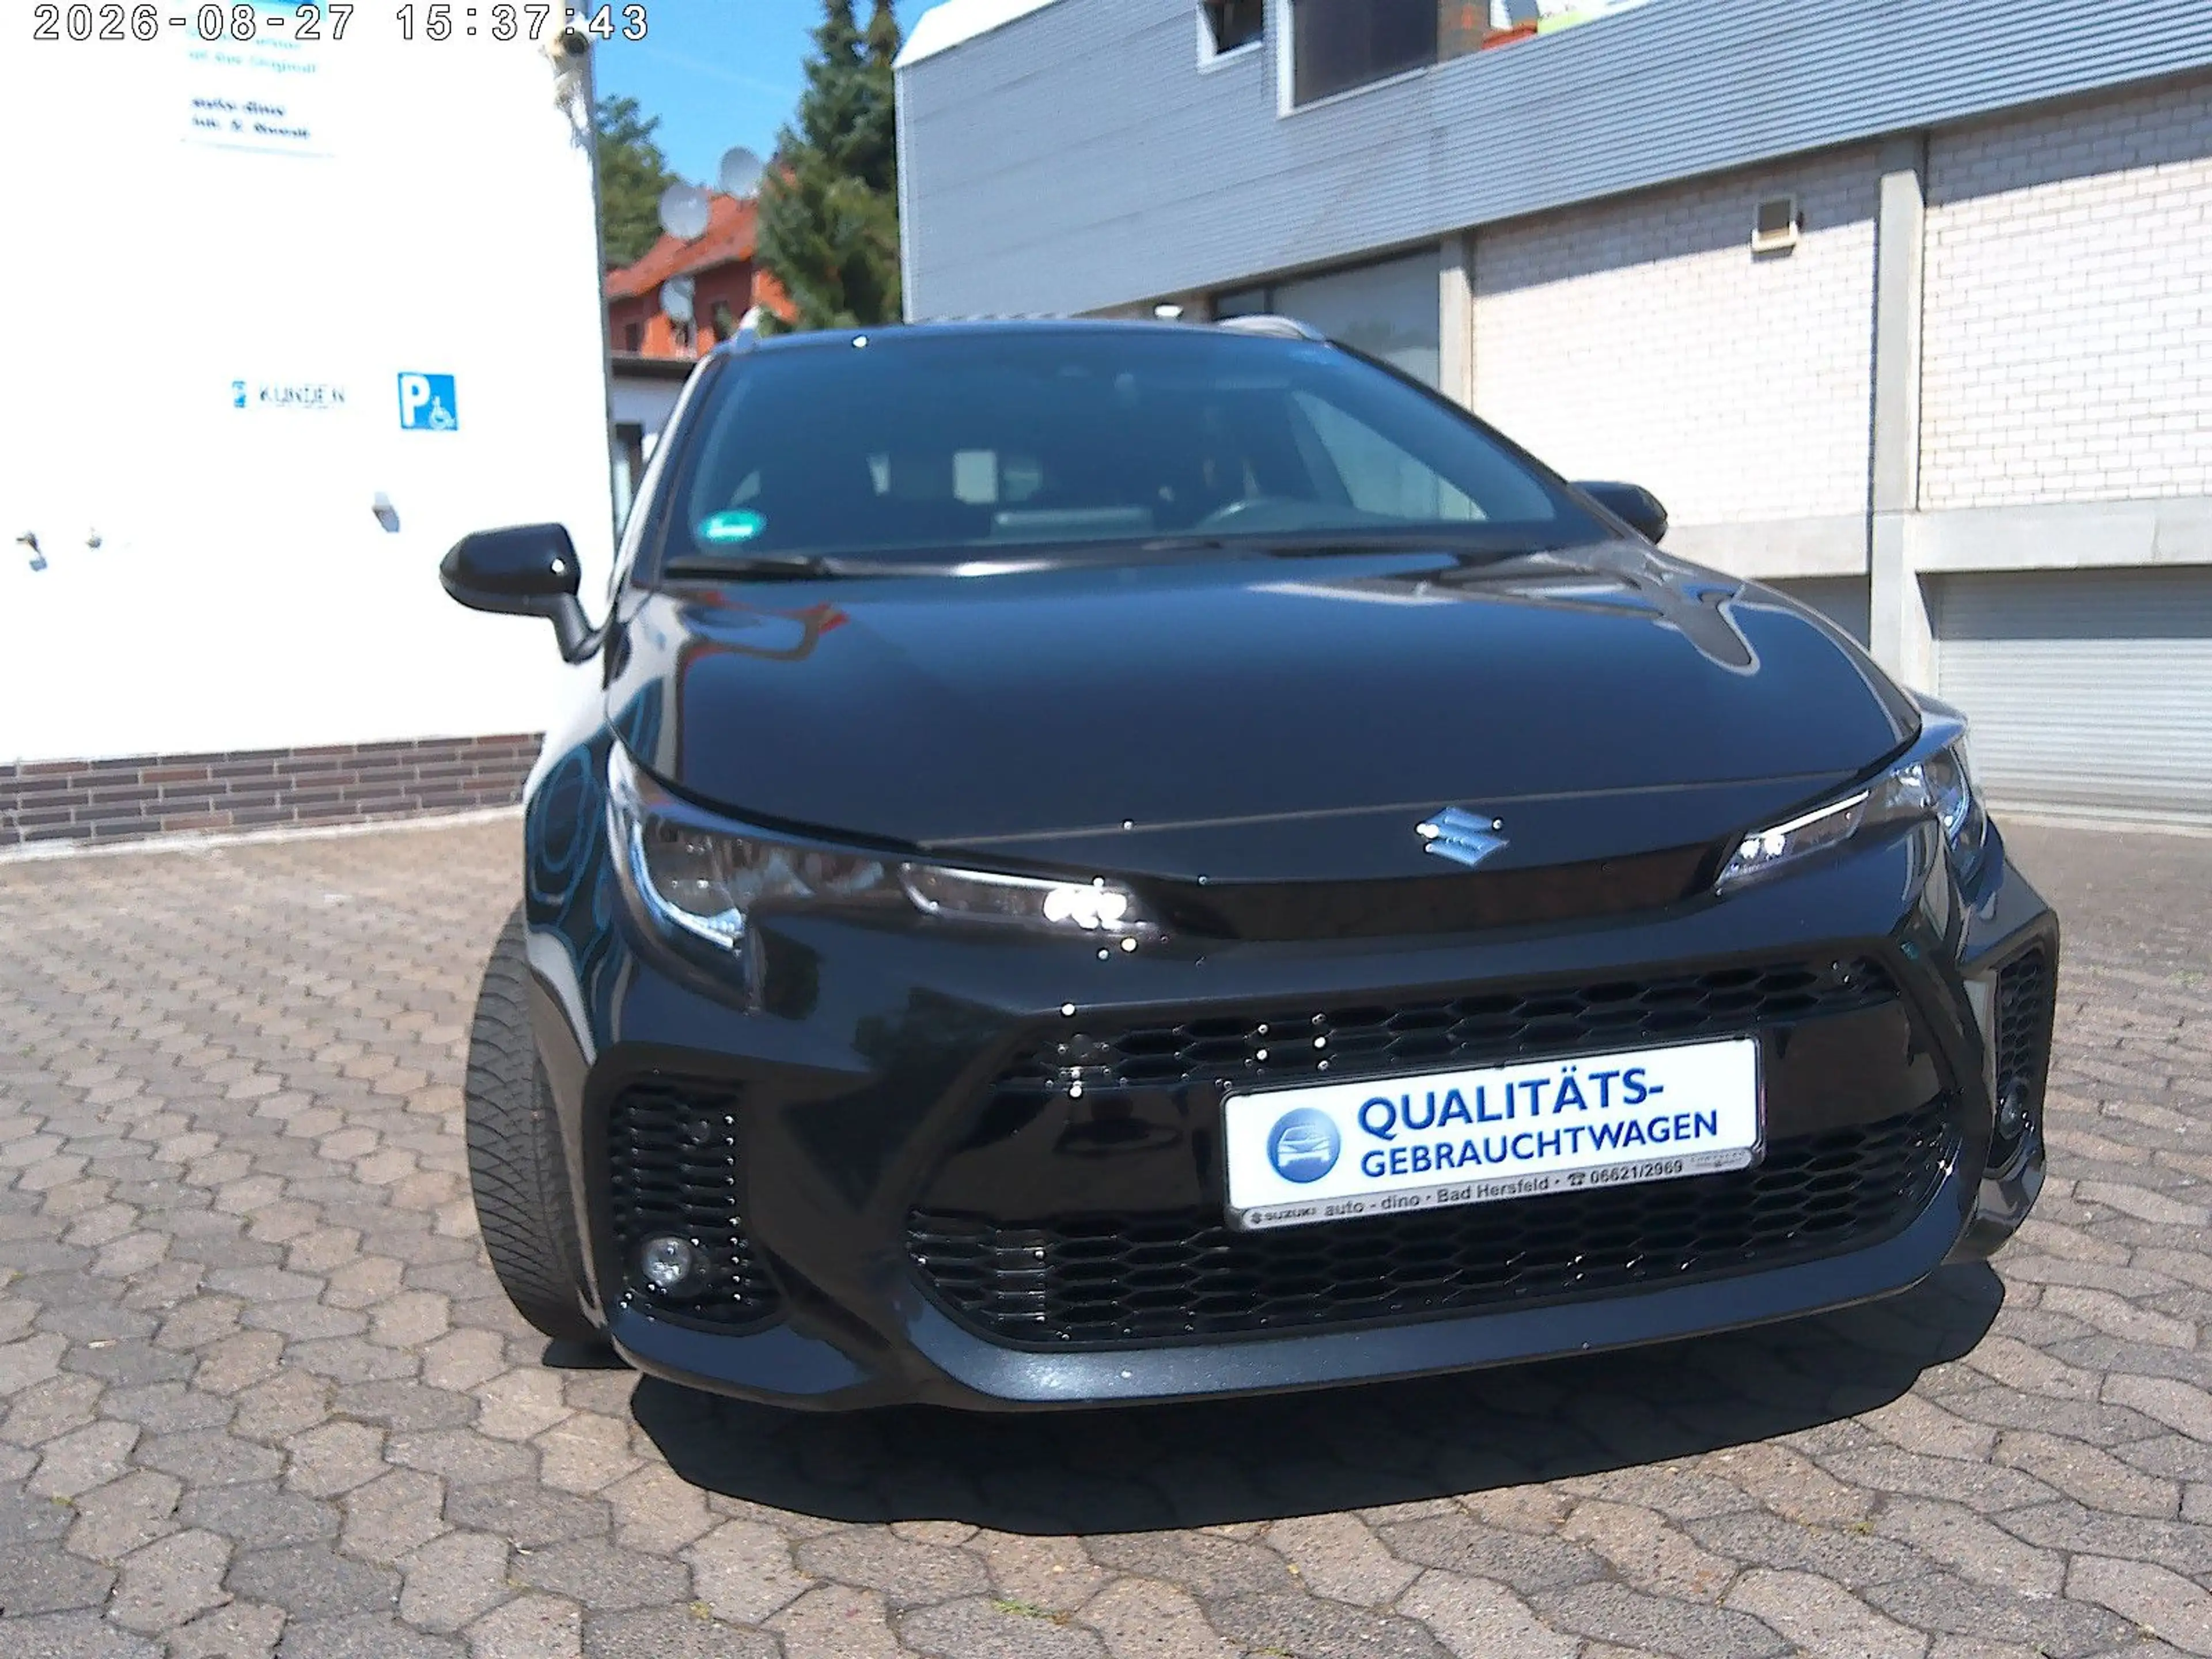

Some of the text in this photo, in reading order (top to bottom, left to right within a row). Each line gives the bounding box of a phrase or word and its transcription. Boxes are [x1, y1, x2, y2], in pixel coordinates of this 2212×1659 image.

[402, 374, 430, 426] P
[1357, 1066, 1664, 1141] QUALITÄTS-
[1360, 1109, 1718, 1177] GEBRAUCHTWAGEN
[1264, 1206, 1317, 1221] SUZUKI
[1324, 1200, 1365, 1217] auto
[1381, 1194, 1419, 1210] dino
[1437, 1184, 1471, 1203] Bad
[1476, 1177, 1550, 1198] Hersfeld
[1590, 1160, 1683, 1184] 06621/2969
